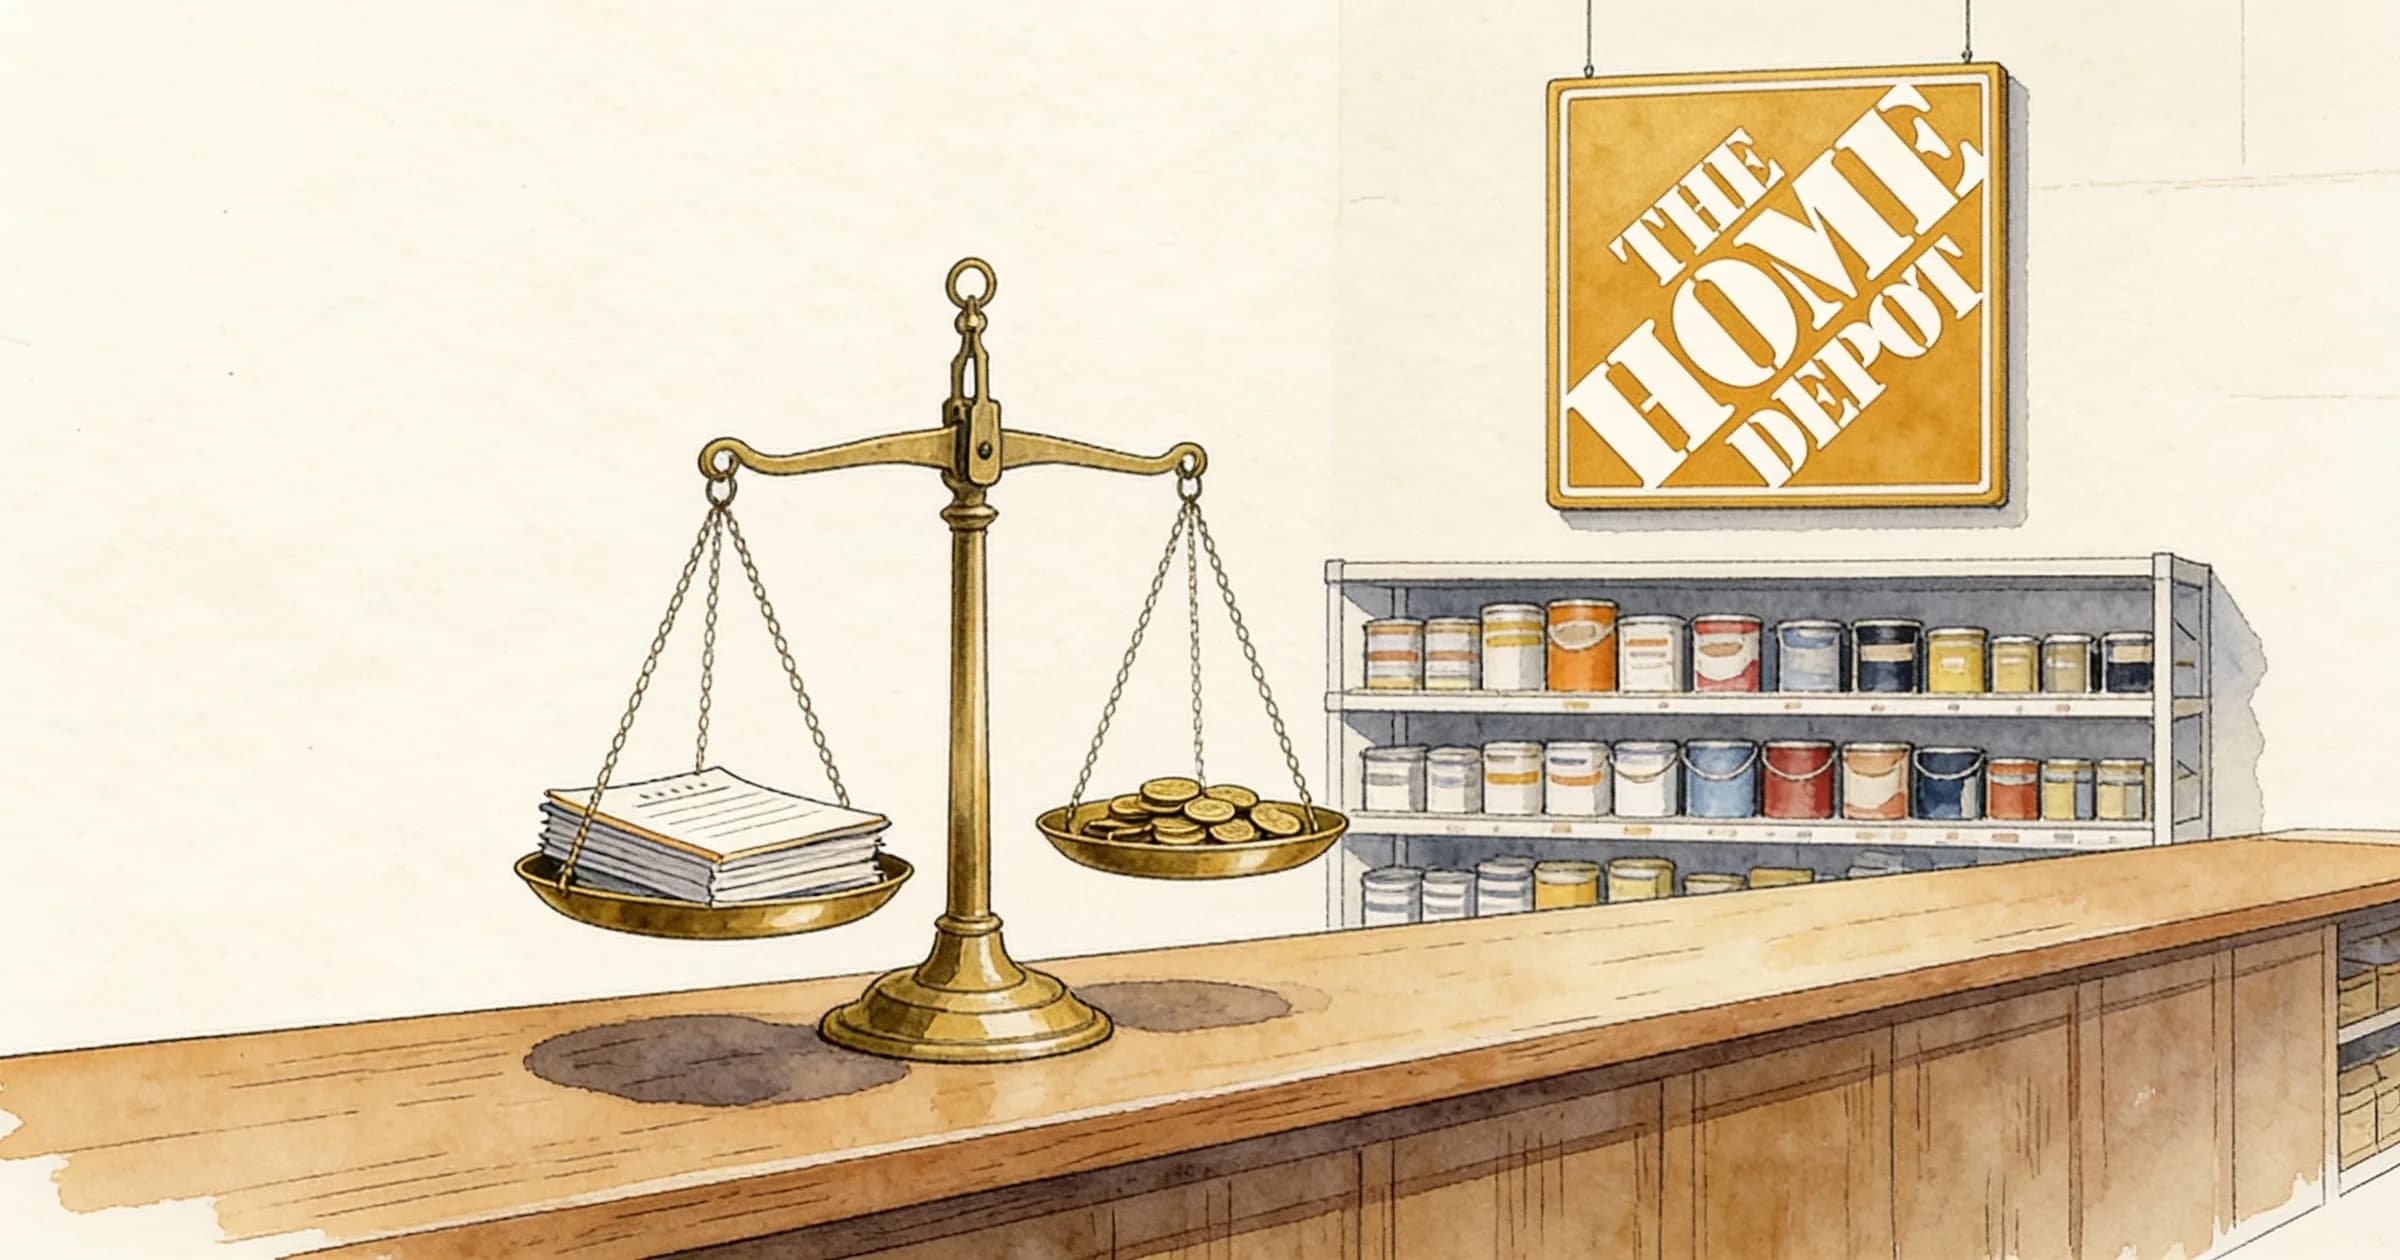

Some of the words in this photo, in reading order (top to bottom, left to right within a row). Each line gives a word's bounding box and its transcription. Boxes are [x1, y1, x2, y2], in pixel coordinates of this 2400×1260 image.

[1566, 82, 1984, 488] HOME
[1608, 126, 1786, 287] THE
[1725, 233, 1984, 488] DEPOT
